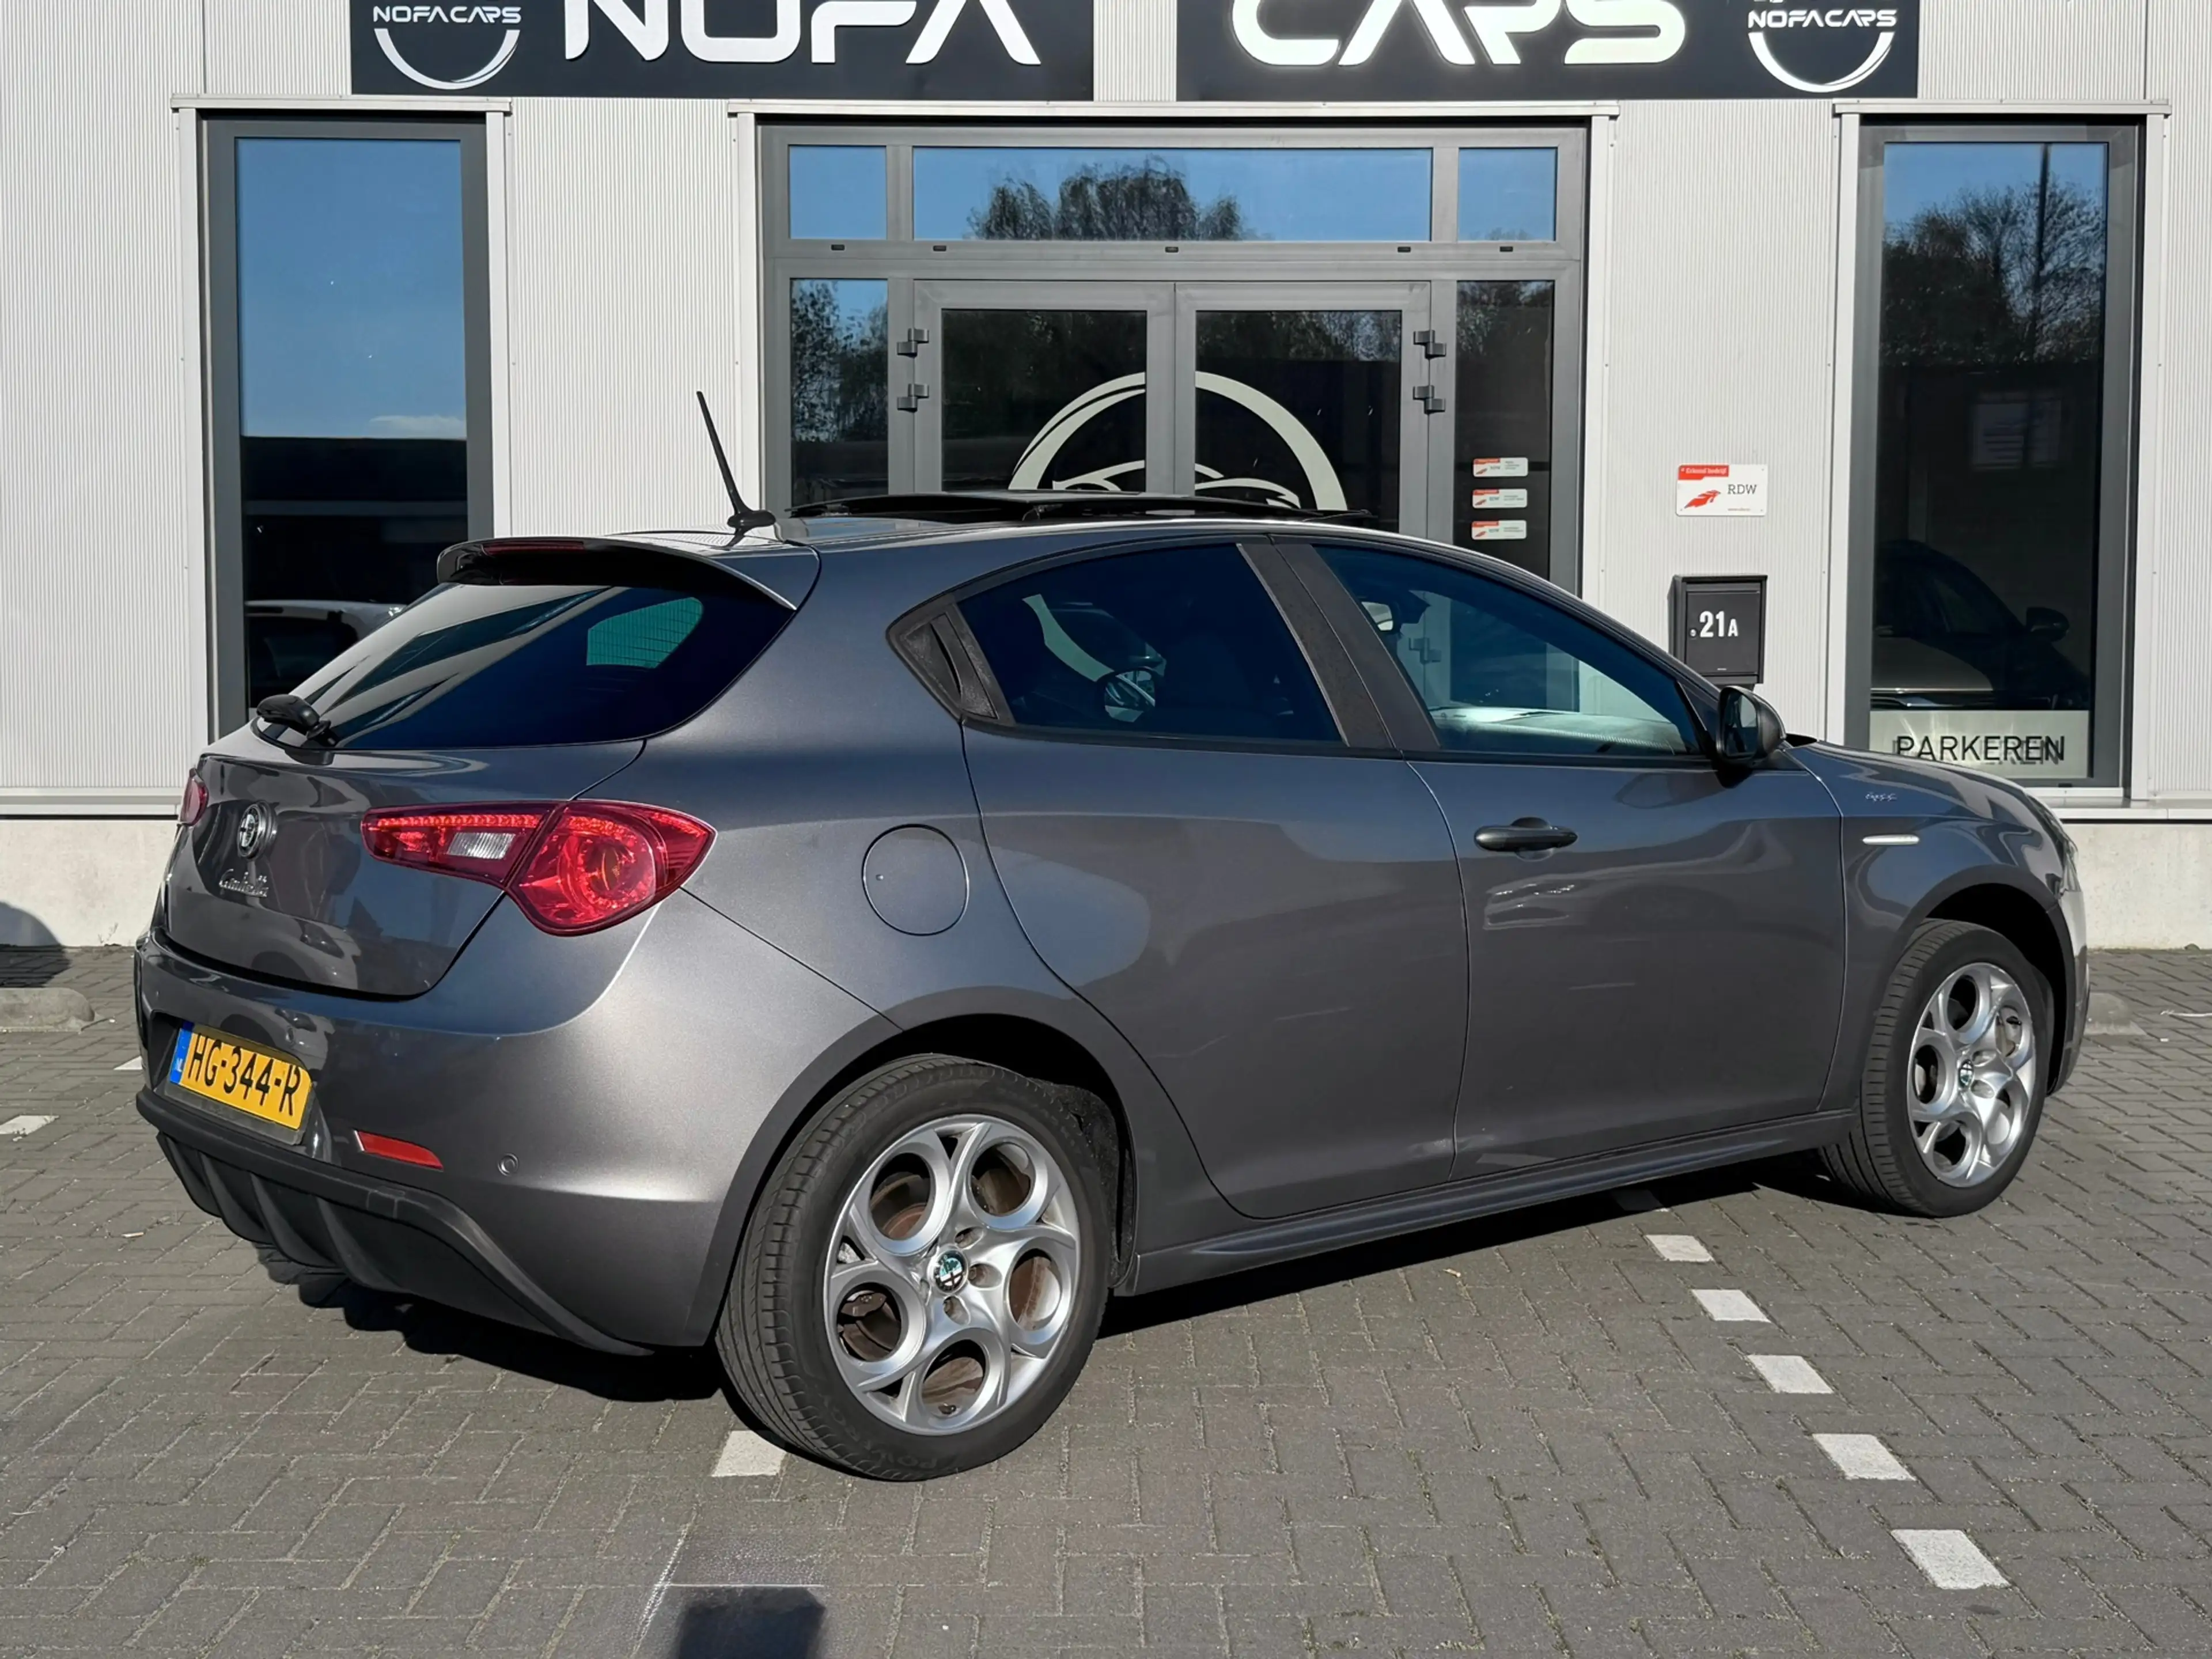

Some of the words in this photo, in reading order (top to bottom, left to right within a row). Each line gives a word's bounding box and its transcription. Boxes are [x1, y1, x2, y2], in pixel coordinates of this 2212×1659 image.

[565, 0, 1041, 64] NOFA
[1232, 0, 1687, 66] CARS
[1728, 484, 1757, 494] RDW
[1896, 735, 2065, 761] PARKEREN
[188, 1033, 301, 1116] HG-344-R
